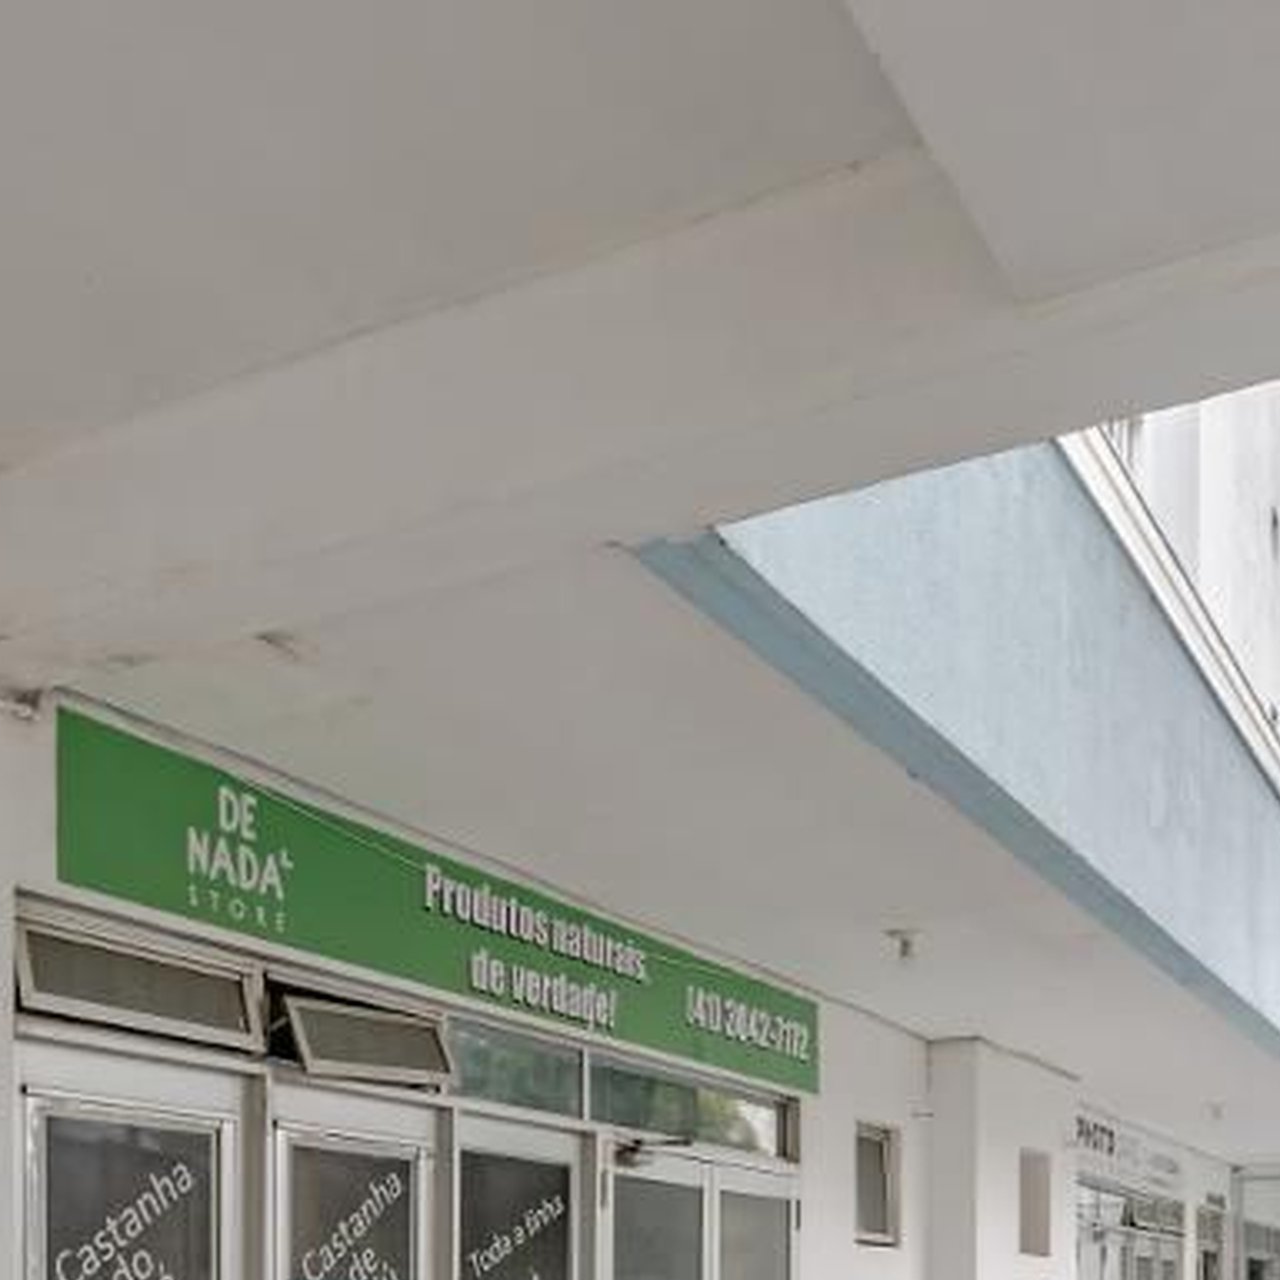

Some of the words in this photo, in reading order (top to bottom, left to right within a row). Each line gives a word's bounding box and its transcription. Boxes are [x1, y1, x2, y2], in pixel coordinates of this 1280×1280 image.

[219, 786, 257, 841] DE
[188, 884, 285, 933] STORE
[425, 863, 549, 947] Produtos
[551, 917, 646, 982] naturais
[471, 949, 506, 995] de
[512, 965, 617, 1029] verdade!
[470, 1231, 513, 1278] Toda
[513, 1225, 526, 1245] a
